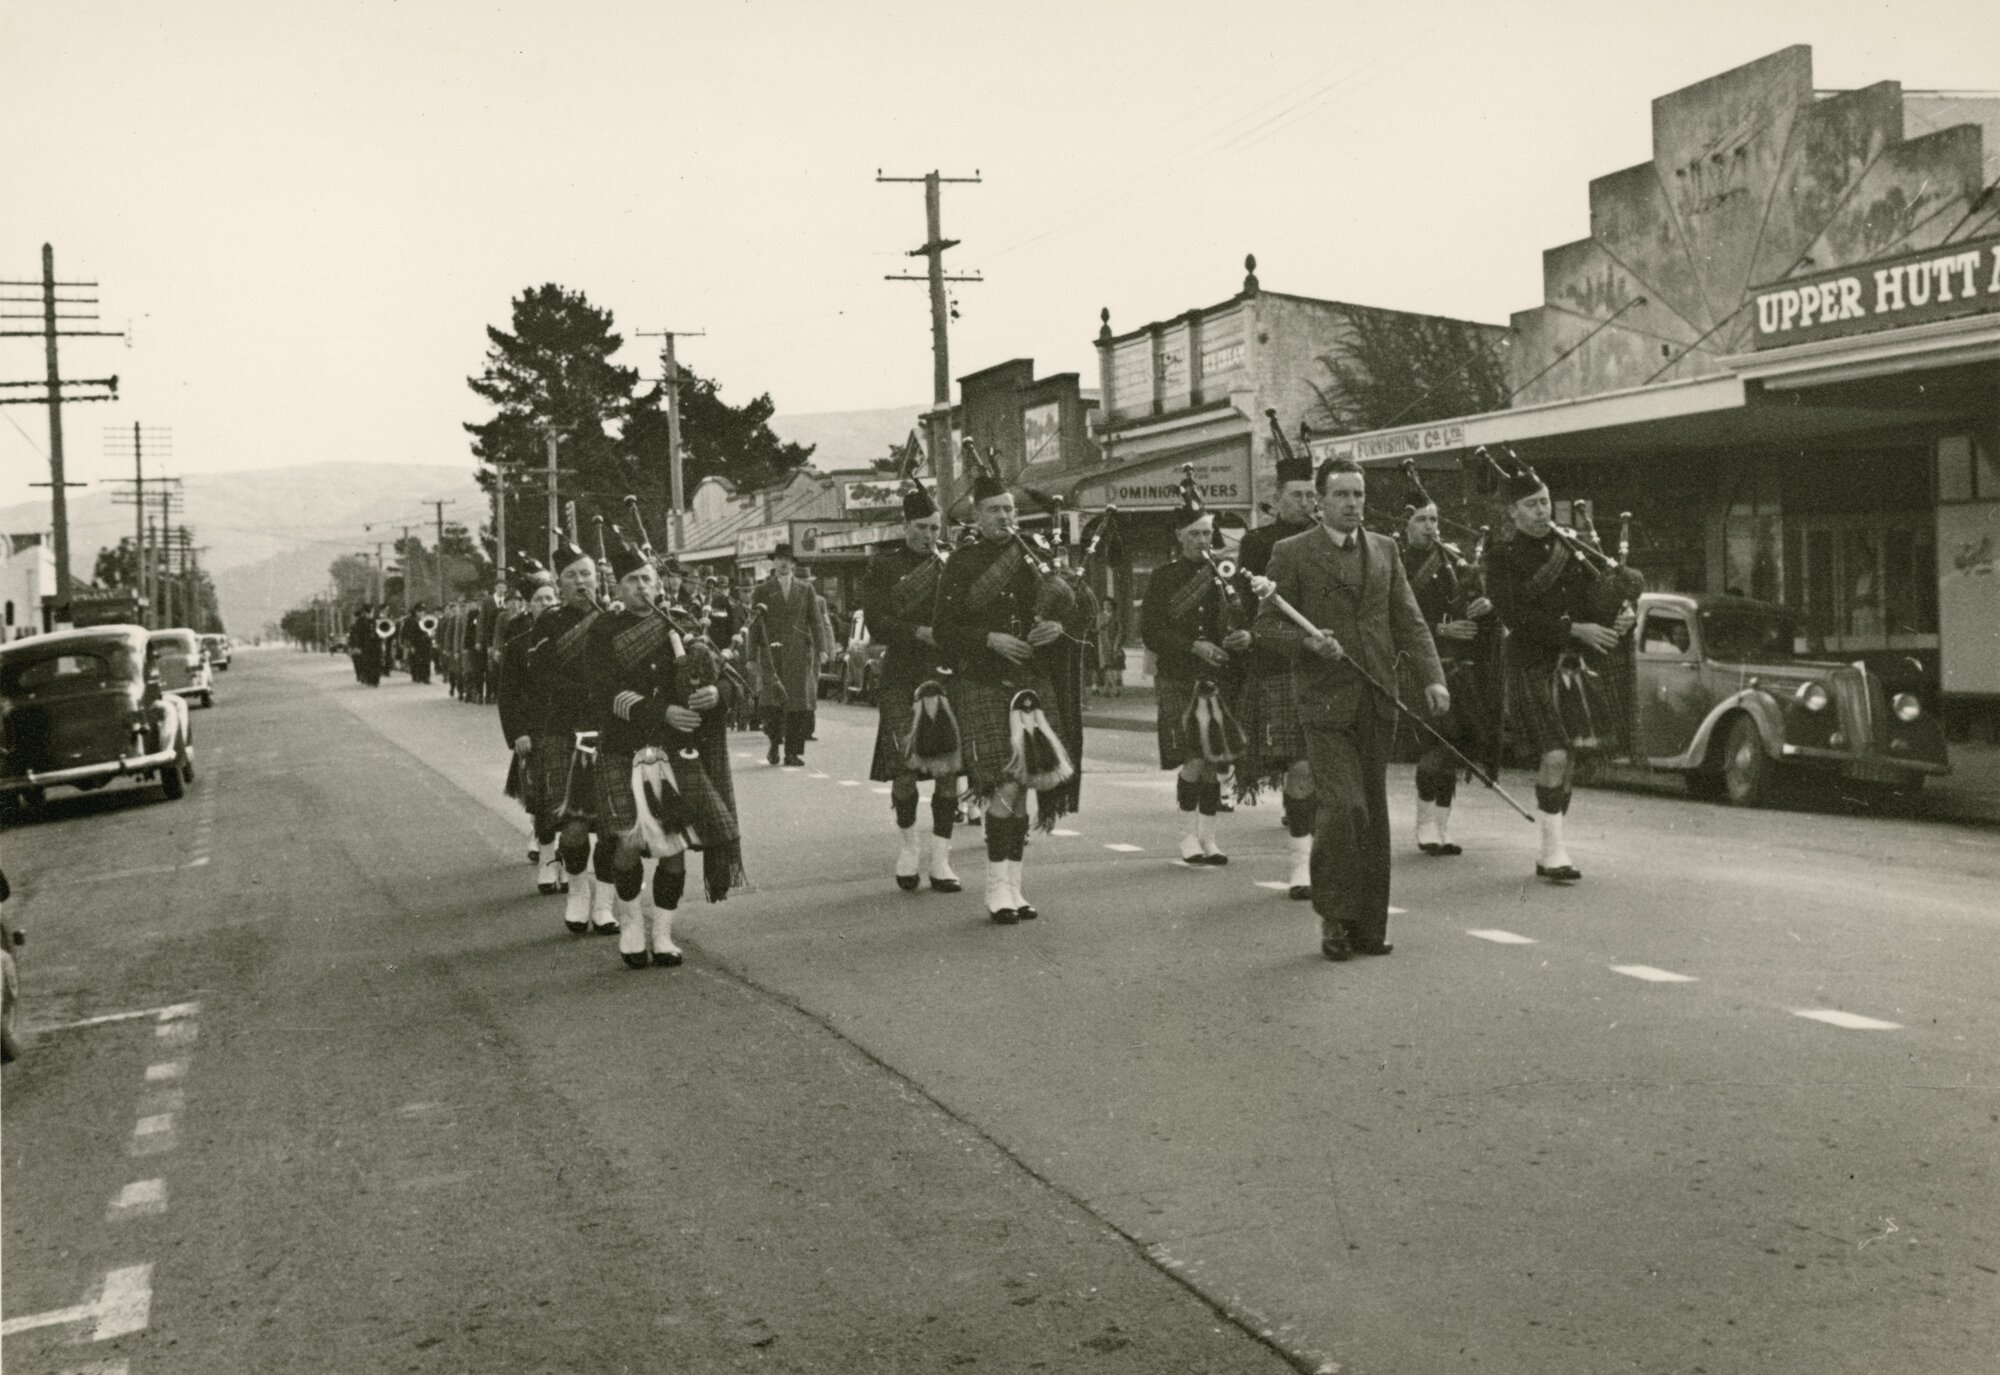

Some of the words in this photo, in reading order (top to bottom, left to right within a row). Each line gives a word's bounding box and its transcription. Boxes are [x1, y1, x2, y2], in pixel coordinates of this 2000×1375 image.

[1756, 277, 1866, 334] UPPER
[1874, 251, 1981, 313] HUTT
[1357, 433, 1420, 458] FURNISHING
